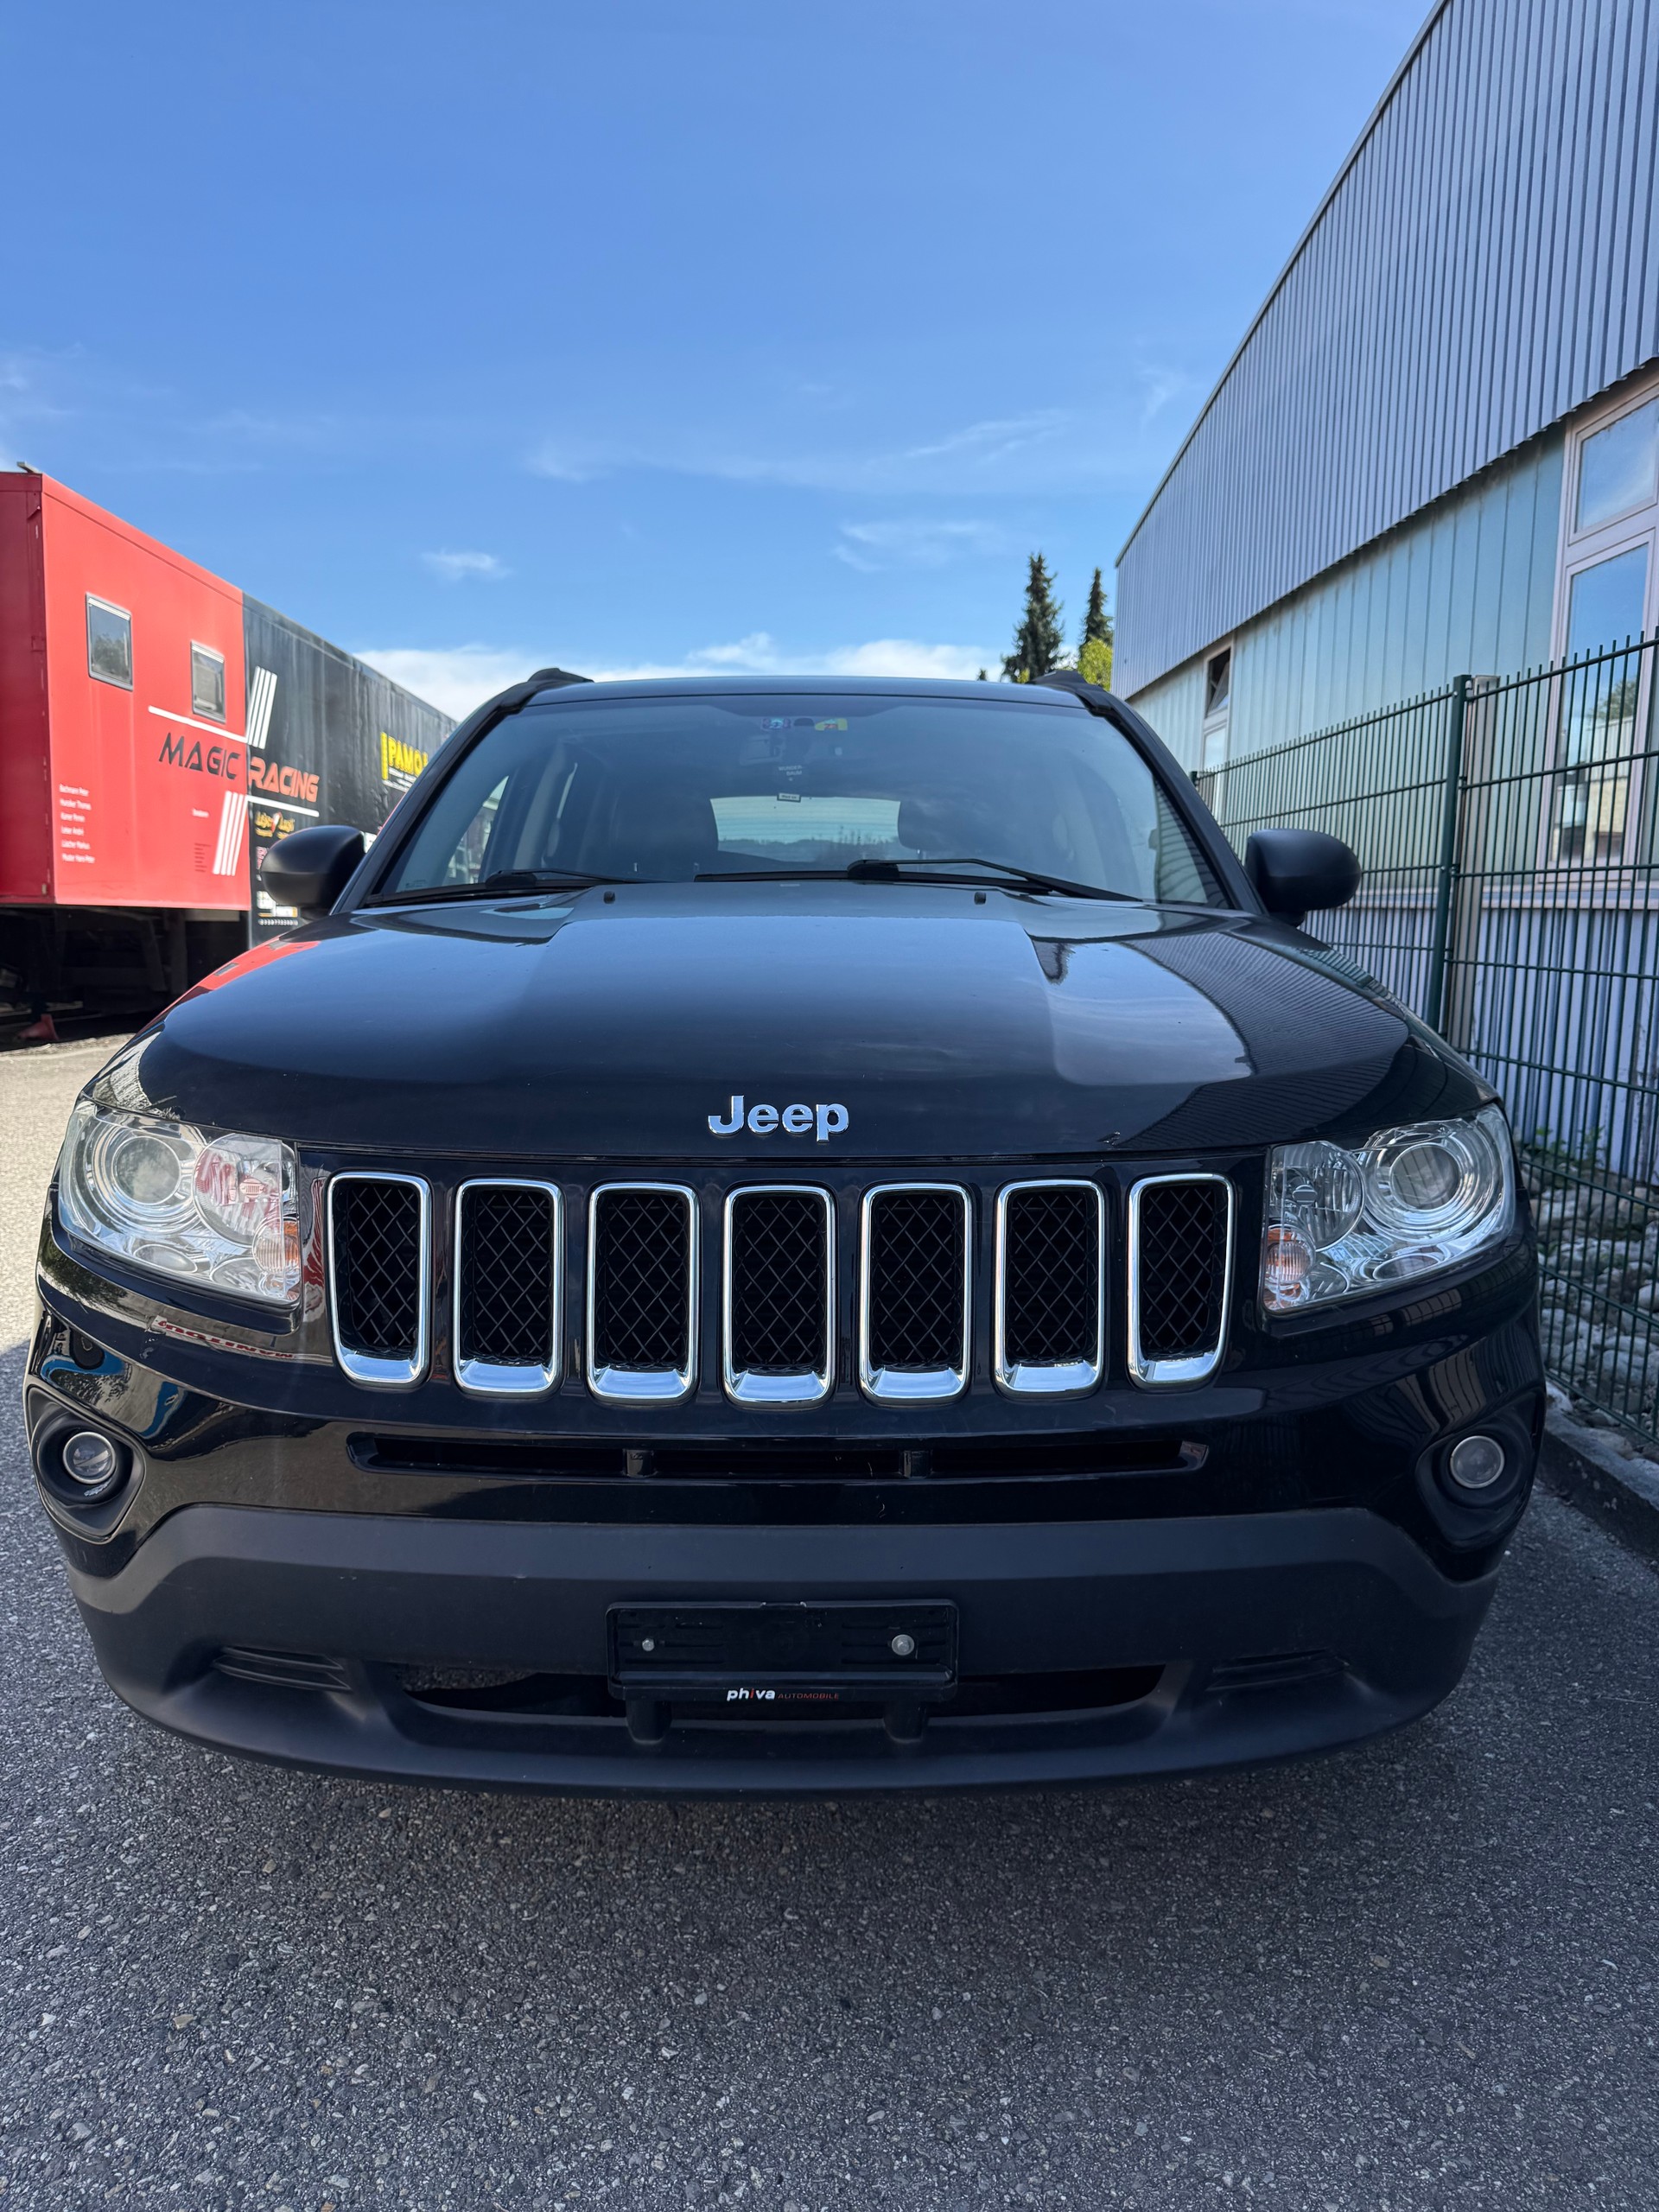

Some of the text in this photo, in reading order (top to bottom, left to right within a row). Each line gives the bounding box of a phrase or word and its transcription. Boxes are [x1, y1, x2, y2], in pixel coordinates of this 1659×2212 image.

[158, 732, 320, 803] MAGIC RACING
[708, 1095, 849, 1142] Jeep
[727, 1688, 776, 1701] phiva
